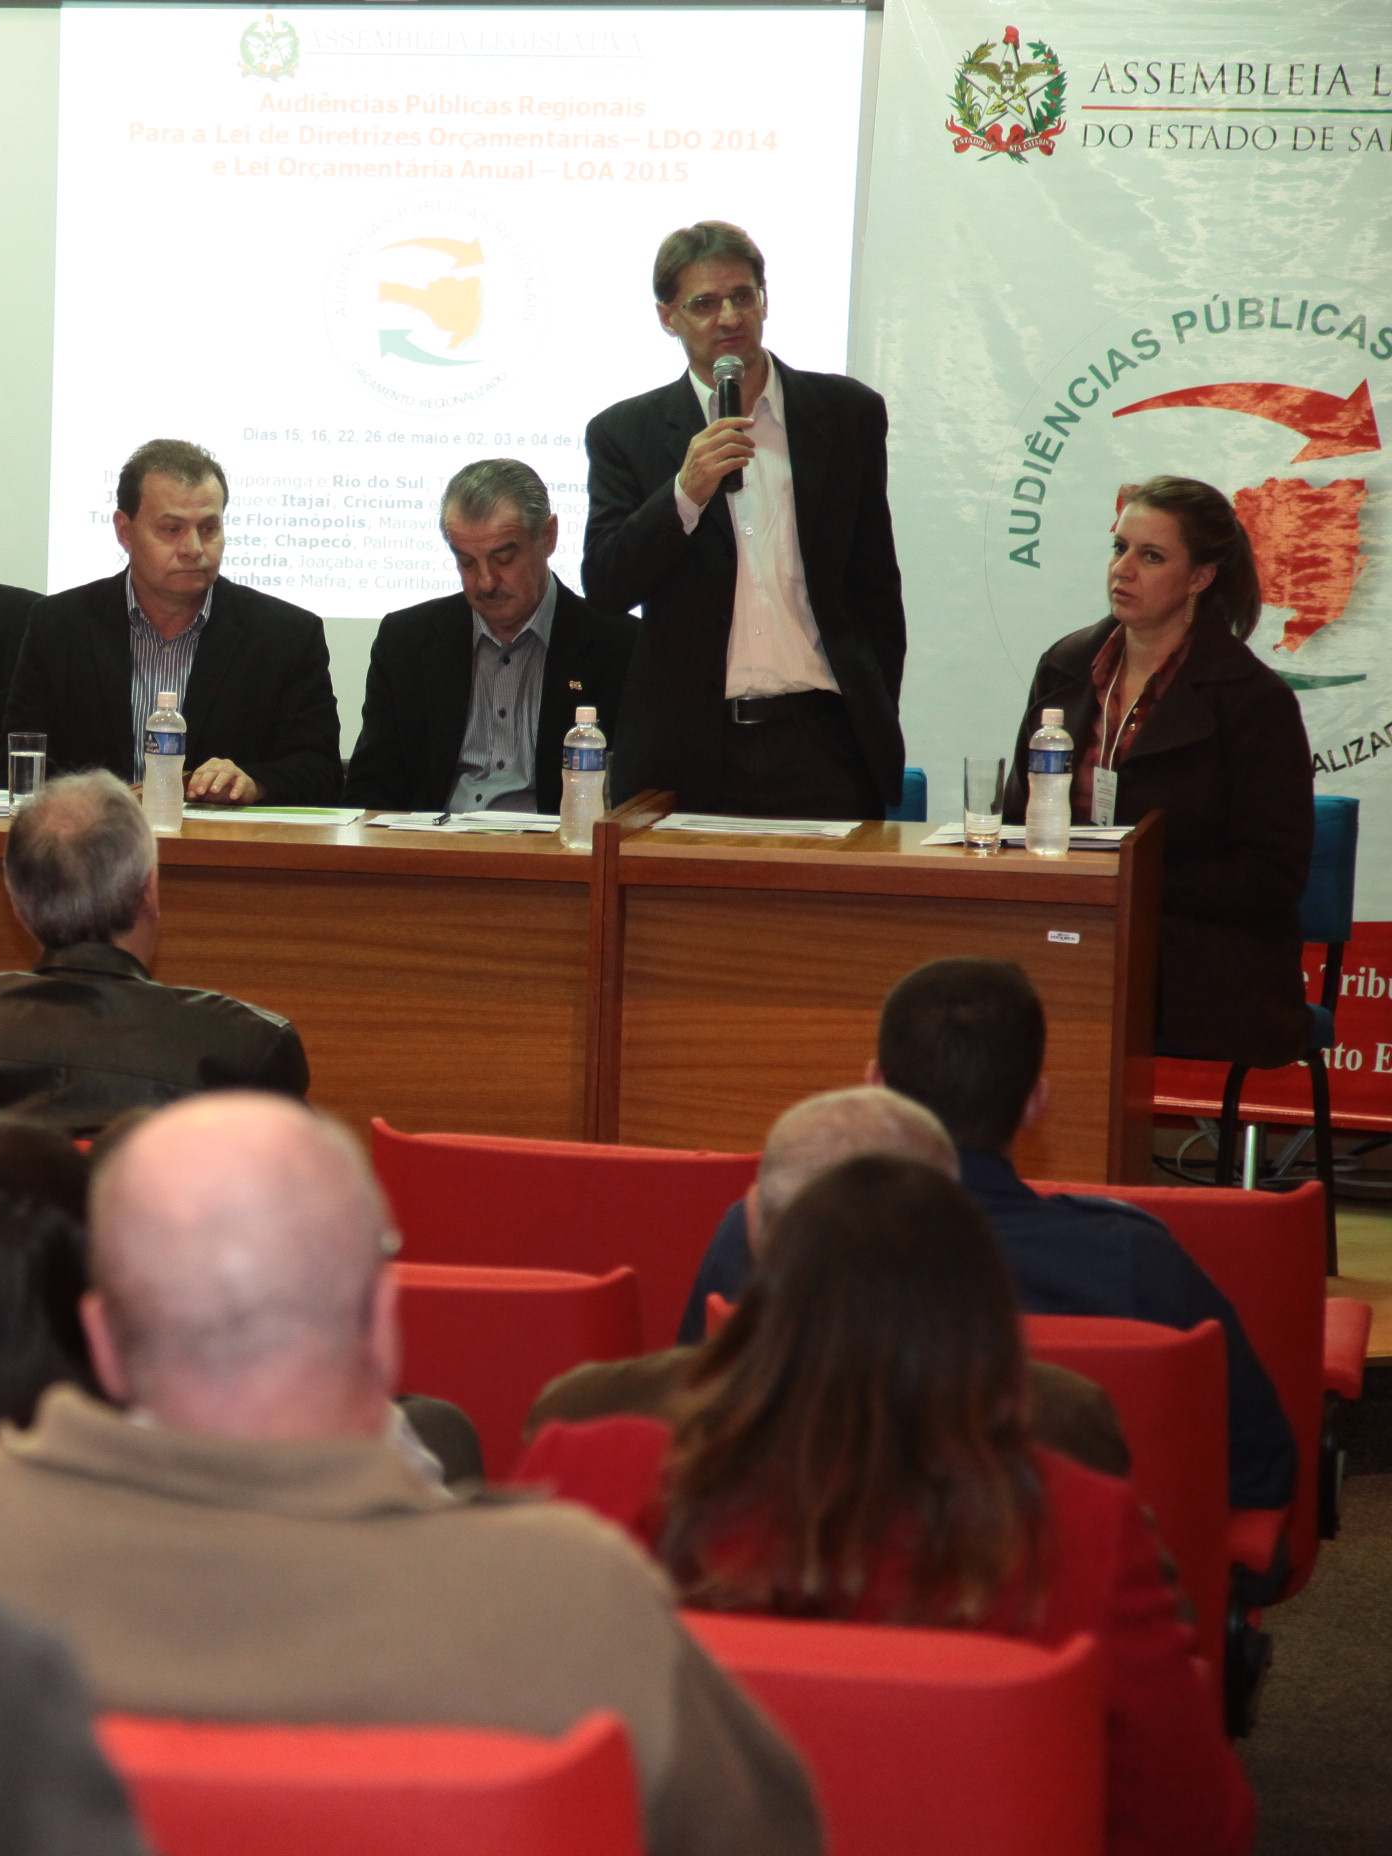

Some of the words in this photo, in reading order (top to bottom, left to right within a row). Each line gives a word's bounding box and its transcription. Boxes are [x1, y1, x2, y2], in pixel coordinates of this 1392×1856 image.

[307, 30, 468, 50] ASSEMBLEIA
[479, 31, 642, 52] LEGISLATIVA
[1088, 61, 1355, 97] ASSEMBLEIA
[259, 92, 399, 114] Audiências
[405, 92, 512, 116] Públicas
[518, 95, 647, 121] Regionais
[129, 121, 185, 144] Para
[192, 127, 207, 144] a
[216, 123, 251, 145] Lei
[258, 123, 290, 145] de
[298, 125, 422, 147] Diretrizes
[428, 126, 621, 152] Orçamentárias
[647, 129, 702, 150] LDO
[710, 130, 778, 151] 2014
[1081, 122, 1134, 149] DO
[1148, 123, 1278, 151] ESTADO
[1292, 126, 1335, 152] DE
[211, 159, 227, 176] e
[234, 156, 270, 177] Lei
[278, 156, 454, 182] Orçamentária
[459, 159, 534, 181] Anual
[563, 160, 614, 181] LOA
[623, 161, 690, 183] 2015
[243, 427, 278, 441] Dias
[364, 429, 382, 444] 26
[387, 430, 406, 445] de
[410, 431, 449, 446] maio
[452, 434, 462, 446] e
[494, 432, 512, 447] 03
[516, 436, 526, 447] e
[530, 432, 548, 447] 04
[553, 433, 572, 448] de
[1008, 328, 1162, 569] AUDIÊNCIAS
[227, 472, 312, 490] tuporanga
[317, 477, 328, 489] e
[332, 474, 361, 489] Rio
[367, 475, 390, 489] do
[267, 496, 277, 508] e
[343, 493, 424, 510] Criciúma
[378, 517, 439, 531] Maravil
[298, 555, 364, 572] Joaçaba
[368, 559, 378, 570] e
[285, 576, 296, 588] e
[358, 578, 369, 590] e
[374, 575, 462, 592] Curitibano
